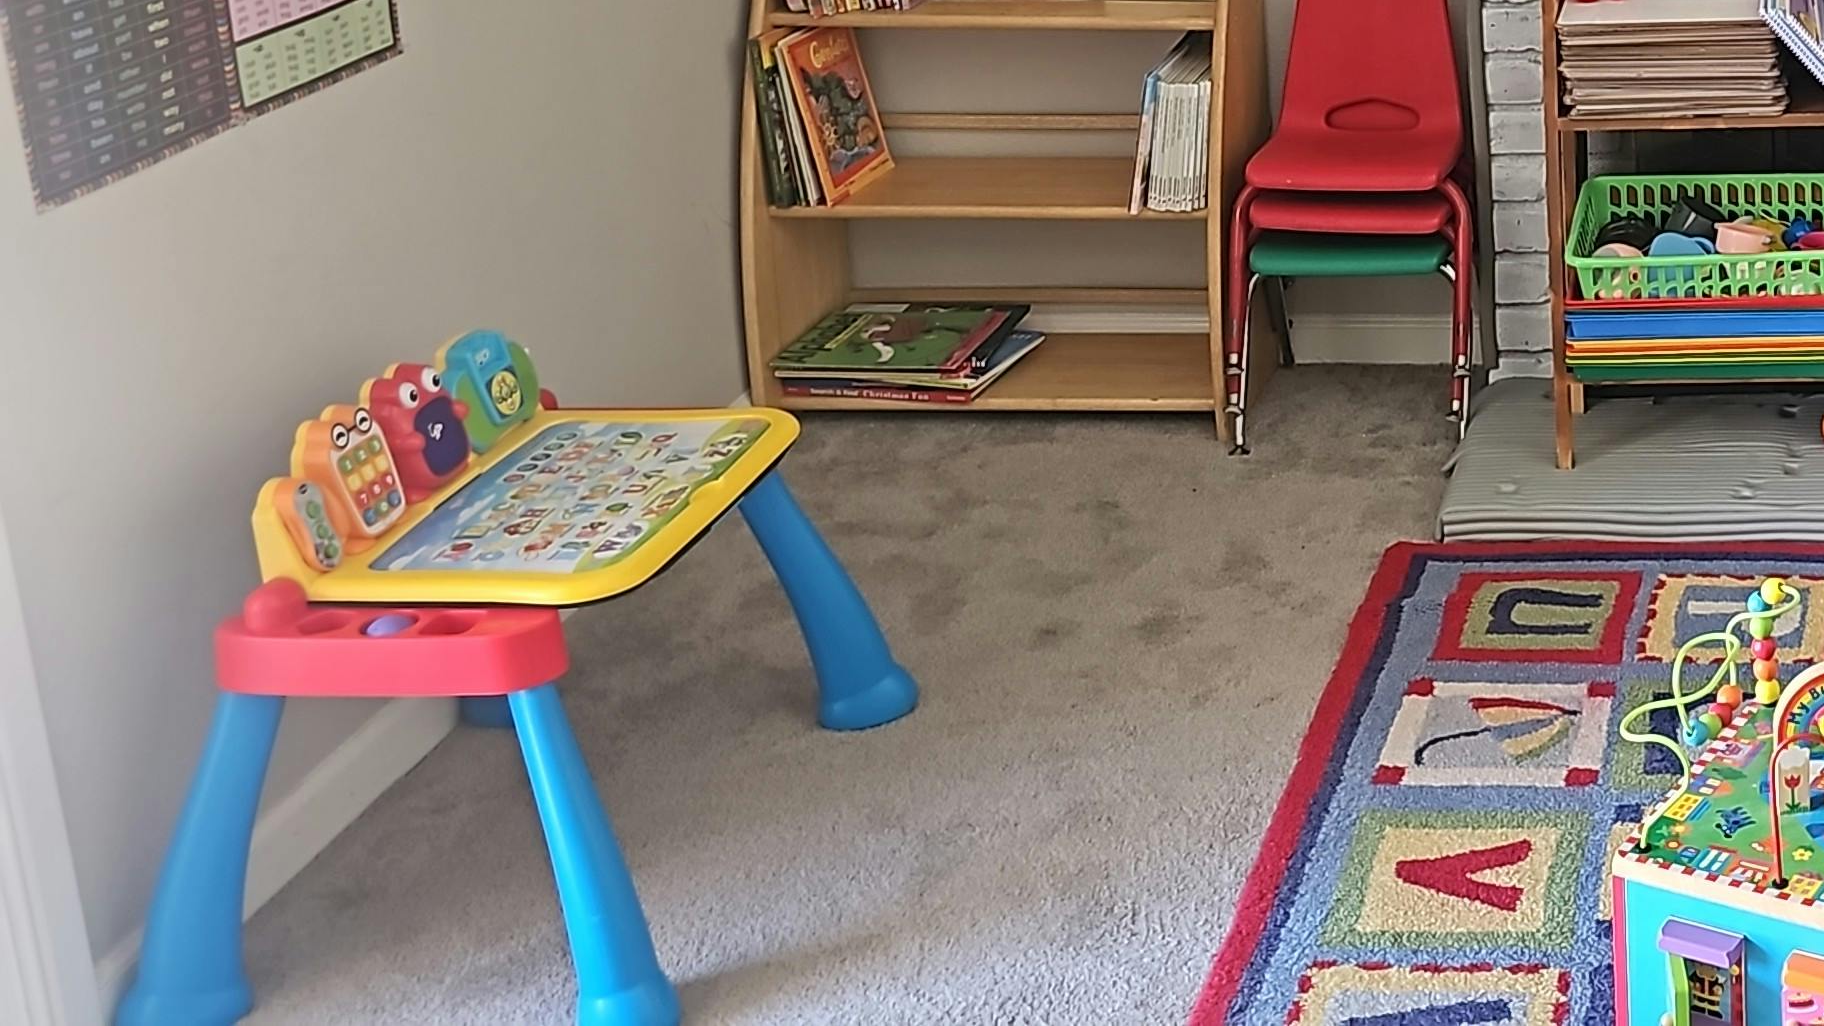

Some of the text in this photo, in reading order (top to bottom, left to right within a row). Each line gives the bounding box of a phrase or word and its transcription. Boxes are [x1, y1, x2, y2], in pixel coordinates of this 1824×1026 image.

[862, 389, 910, 399] Christmas
[911, 391, 929, 401] Fun
[1486, 586, 1604, 635] U
[1787, 701, 1810, 725] My
[1395, 838, 1534, 913] V
